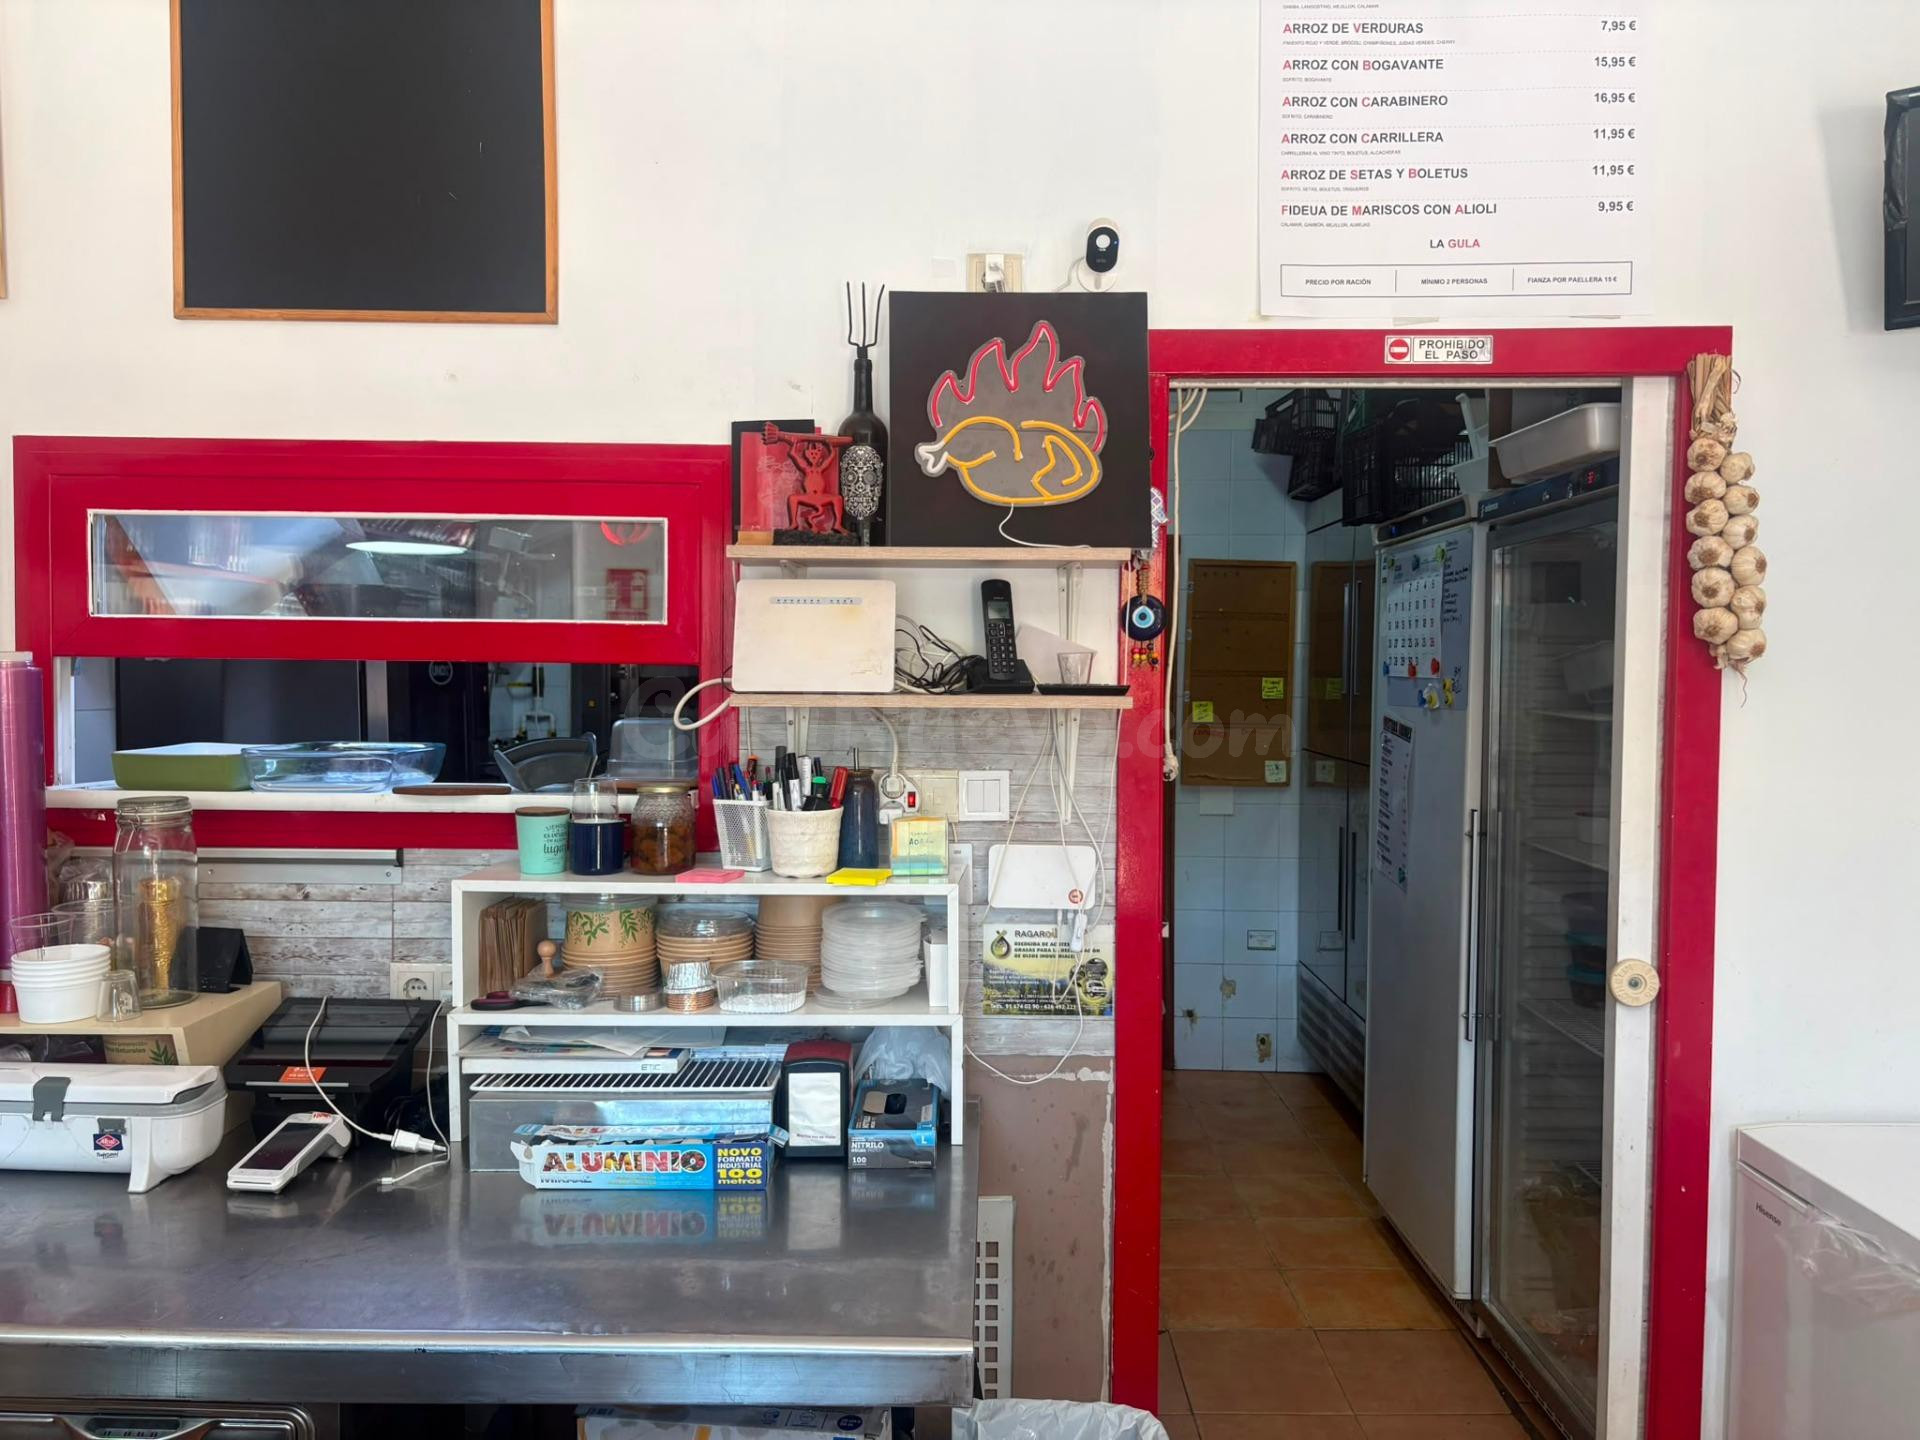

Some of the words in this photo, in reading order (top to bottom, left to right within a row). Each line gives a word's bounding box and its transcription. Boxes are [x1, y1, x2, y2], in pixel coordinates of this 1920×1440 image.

[1282, 22, 1328, 34] ARROZ
[1332, 22, 1350, 34] DE
[1353, 22, 1424, 34] VERDURAS
[1600, 20, 1626, 32] 7,95
[1628, 20, 1637, 31] €
[1282, 59, 1328, 70] ARROZ
[1331, 59, 1359, 70] CON
[1362, 59, 1444, 70] BOGAVANTE
[1594, 56, 1626, 68] 15,95
[1628, 56, 1637, 68] €
[1282, 96, 1327, 108] ARROZ
[1330, 96, 1358, 108] CON
[1361, 96, 1448, 108] CARABINERO
[1594, 92, 1626, 104] 16,95
[1628, 92, 1636, 103] €
[1281, 133, 1326, 144] ARROZ
[1329, 132, 1358, 144] CON
[1361, 132, 1444, 144] CARRILLERA
[1593, 128, 1625, 141] 11,95
[1628, 128, 1636, 140] €
[1281, 170, 1326, 180] ARROZ
[1329, 170, 1346, 180] DE
[1350, 168, 1392, 180] SETAS
[1396, 168, 1404, 180] Y
[1408, 168, 1468, 180] BOLETUS
[1592, 164, 1624, 178] 11,95
[1626, 164, 1635, 176] €
[1281, 204, 1328, 216] FIDEUA
[1331, 204, 1348, 216] DE
[1352, 204, 1420, 216] MARISCOS
[1424, 204, 1451, 215] CON
[1454, 203, 1498, 214] ALIOLI
[1598, 200, 1624, 214] 9,95
[1626, 200, 1634, 212] €
[1430, 238, 1445, 249] LA
[1448, 238, 1481, 248] GULA
[1528, 276, 1552, 284] FIANZA
[1552, 276, 1566, 284] POR
[1568, 276, 1603, 284] PAELLERA
[1418, 340, 1486, 350] PROHIBIDO
[1424, 350, 1440, 360] EL
[1446, 350, 1478, 360] PASO
[921, 1136, 928, 1144] L
[717, 1148, 762, 1156] NOVO
[542, 1150, 707, 1173] ALUMINIO
[716, 1168, 763, 1178] 100
